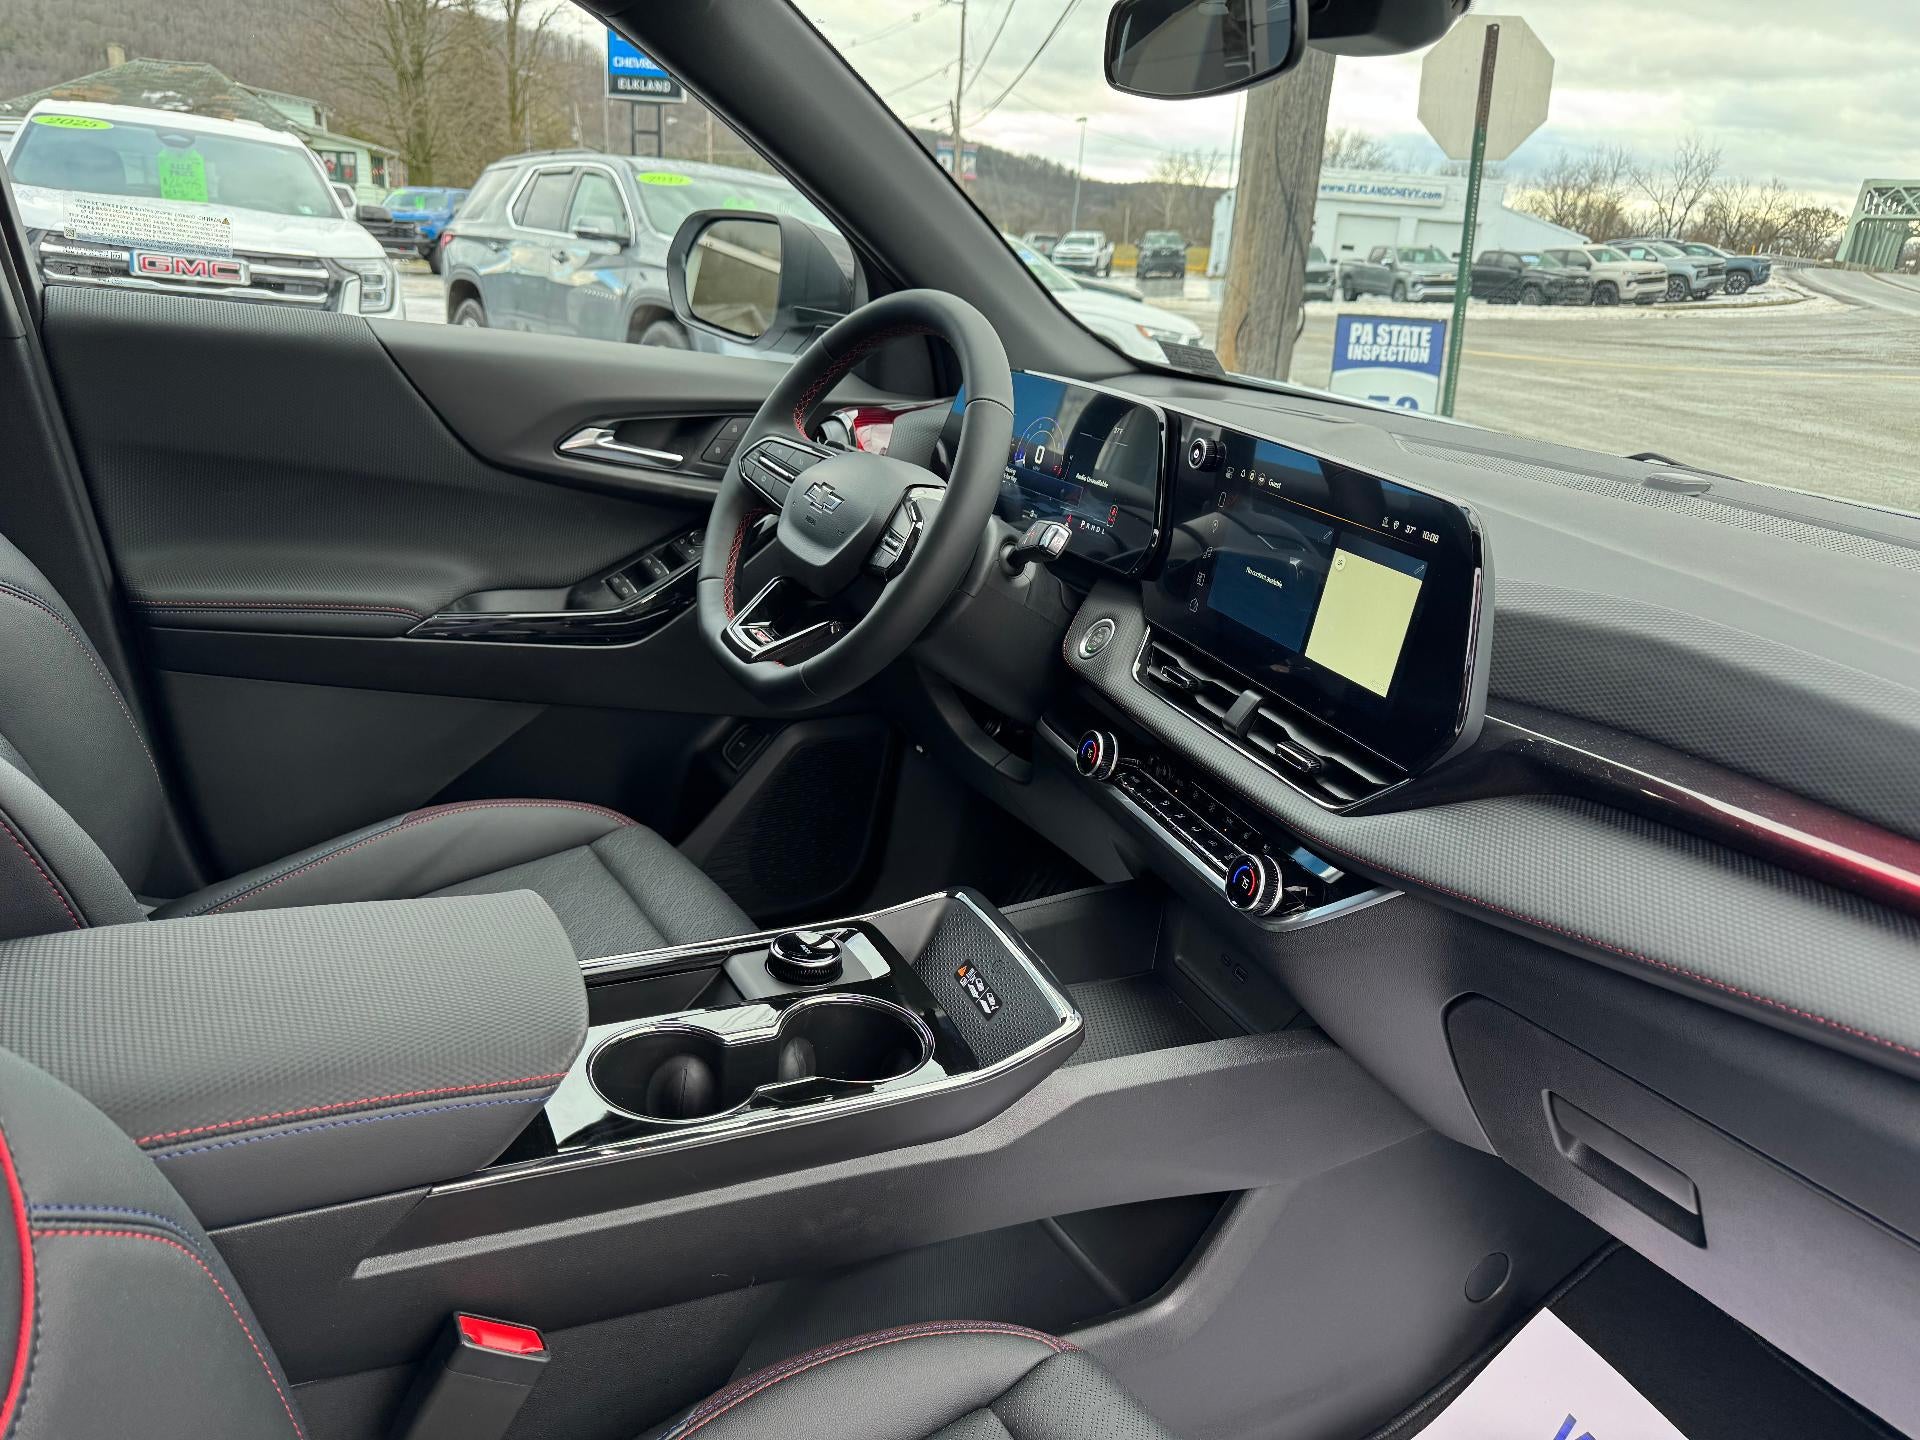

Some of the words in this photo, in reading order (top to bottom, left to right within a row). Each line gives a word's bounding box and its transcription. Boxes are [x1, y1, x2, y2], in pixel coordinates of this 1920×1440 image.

[617, 77, 671, 93] ELKLAND
[1320, 183, 1442, 200] www.ELKLANDCHEVY.com
[140, 255, 241, 280] GMC
[1348, 322, 1374, 345] PA
[1376, 323, 1433, 347] STATE
[1346, 343, 1431, 364] INSPECTION
[1034, 445, 1046, 465] 0
[1422, 530, 1440, 544] 10:08
